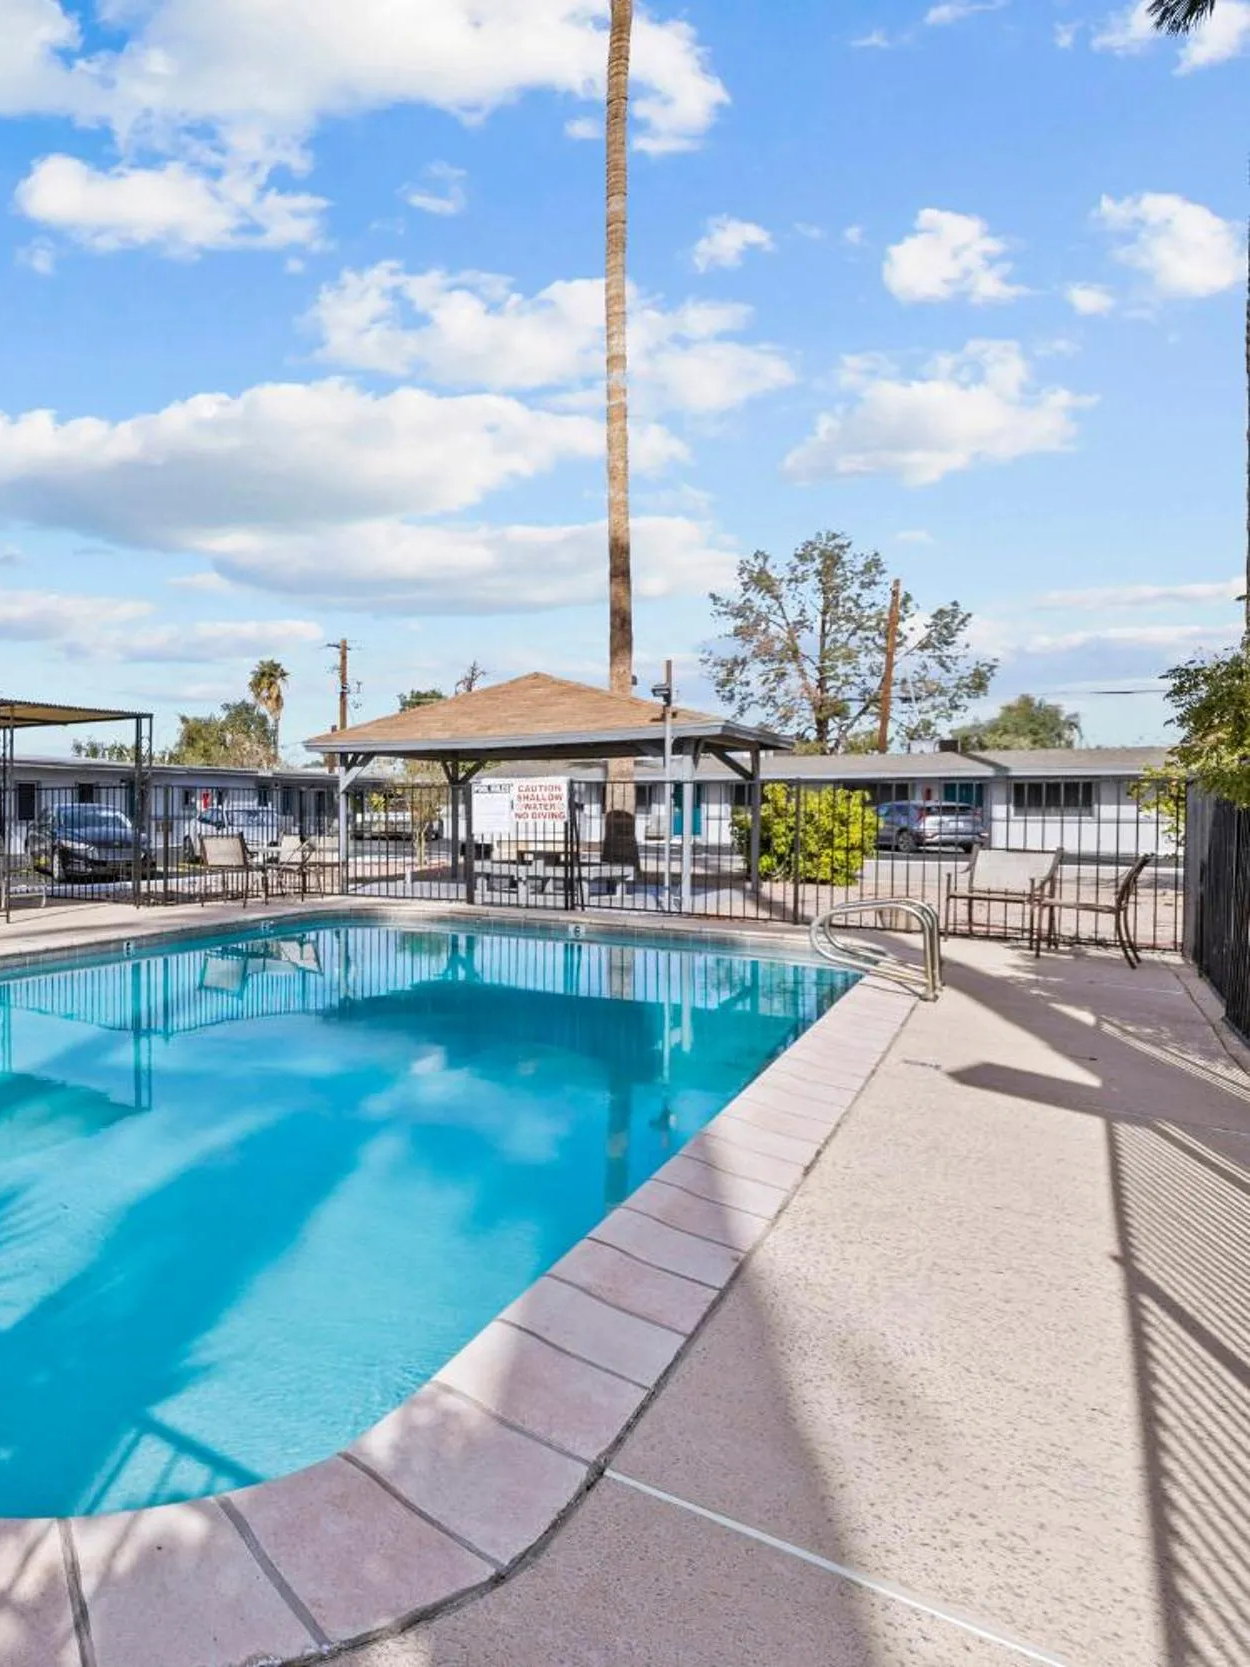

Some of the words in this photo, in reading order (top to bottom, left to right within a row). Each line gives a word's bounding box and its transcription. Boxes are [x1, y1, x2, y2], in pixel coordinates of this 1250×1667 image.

[517, 784, 562, 793] CAUTION
[516, 793, 563, 801] SHALLOW
[524, 802, 556, 810] WATER
[514, 811, 529, 819] NO
[531, 811, 566, 819] DIVING
